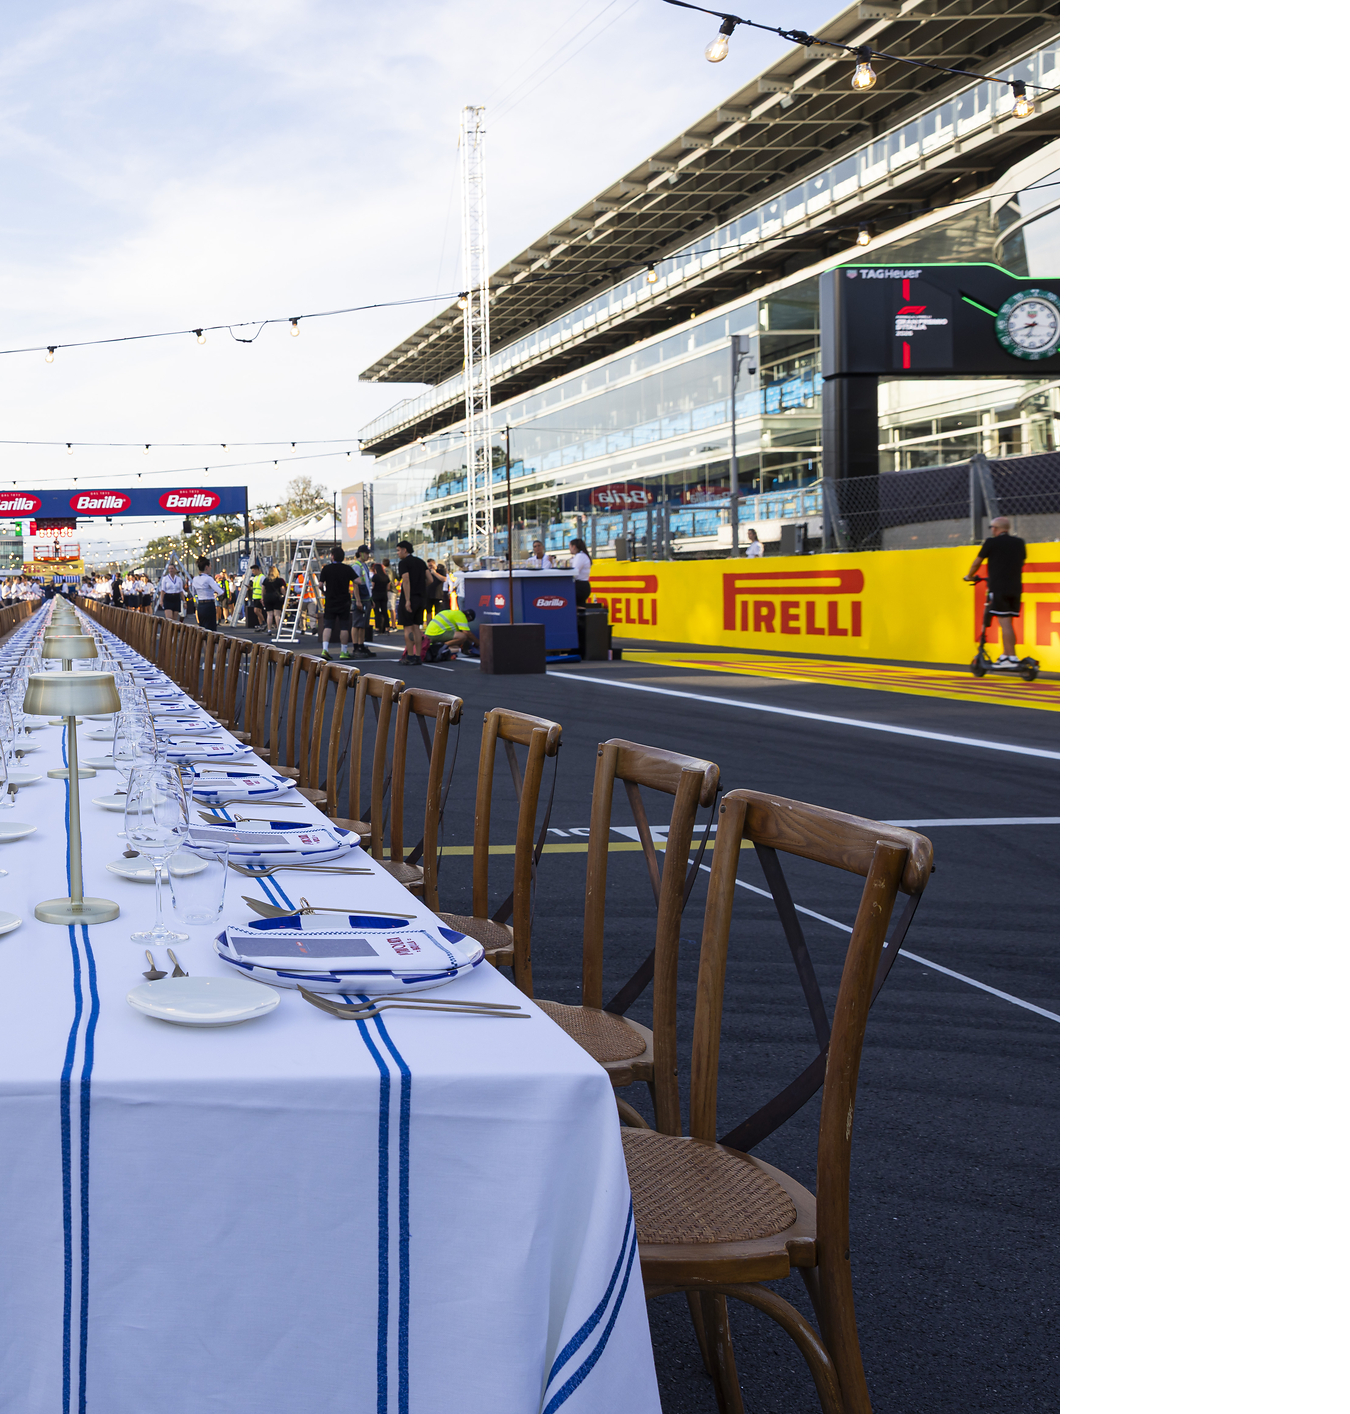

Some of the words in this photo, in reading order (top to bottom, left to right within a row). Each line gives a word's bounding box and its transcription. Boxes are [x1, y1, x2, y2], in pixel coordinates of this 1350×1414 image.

[76, 495, 123, 509] Barilla
[166, 494, 212, 508] Barilla
[722, 569, 865, 637] PIRELLI
